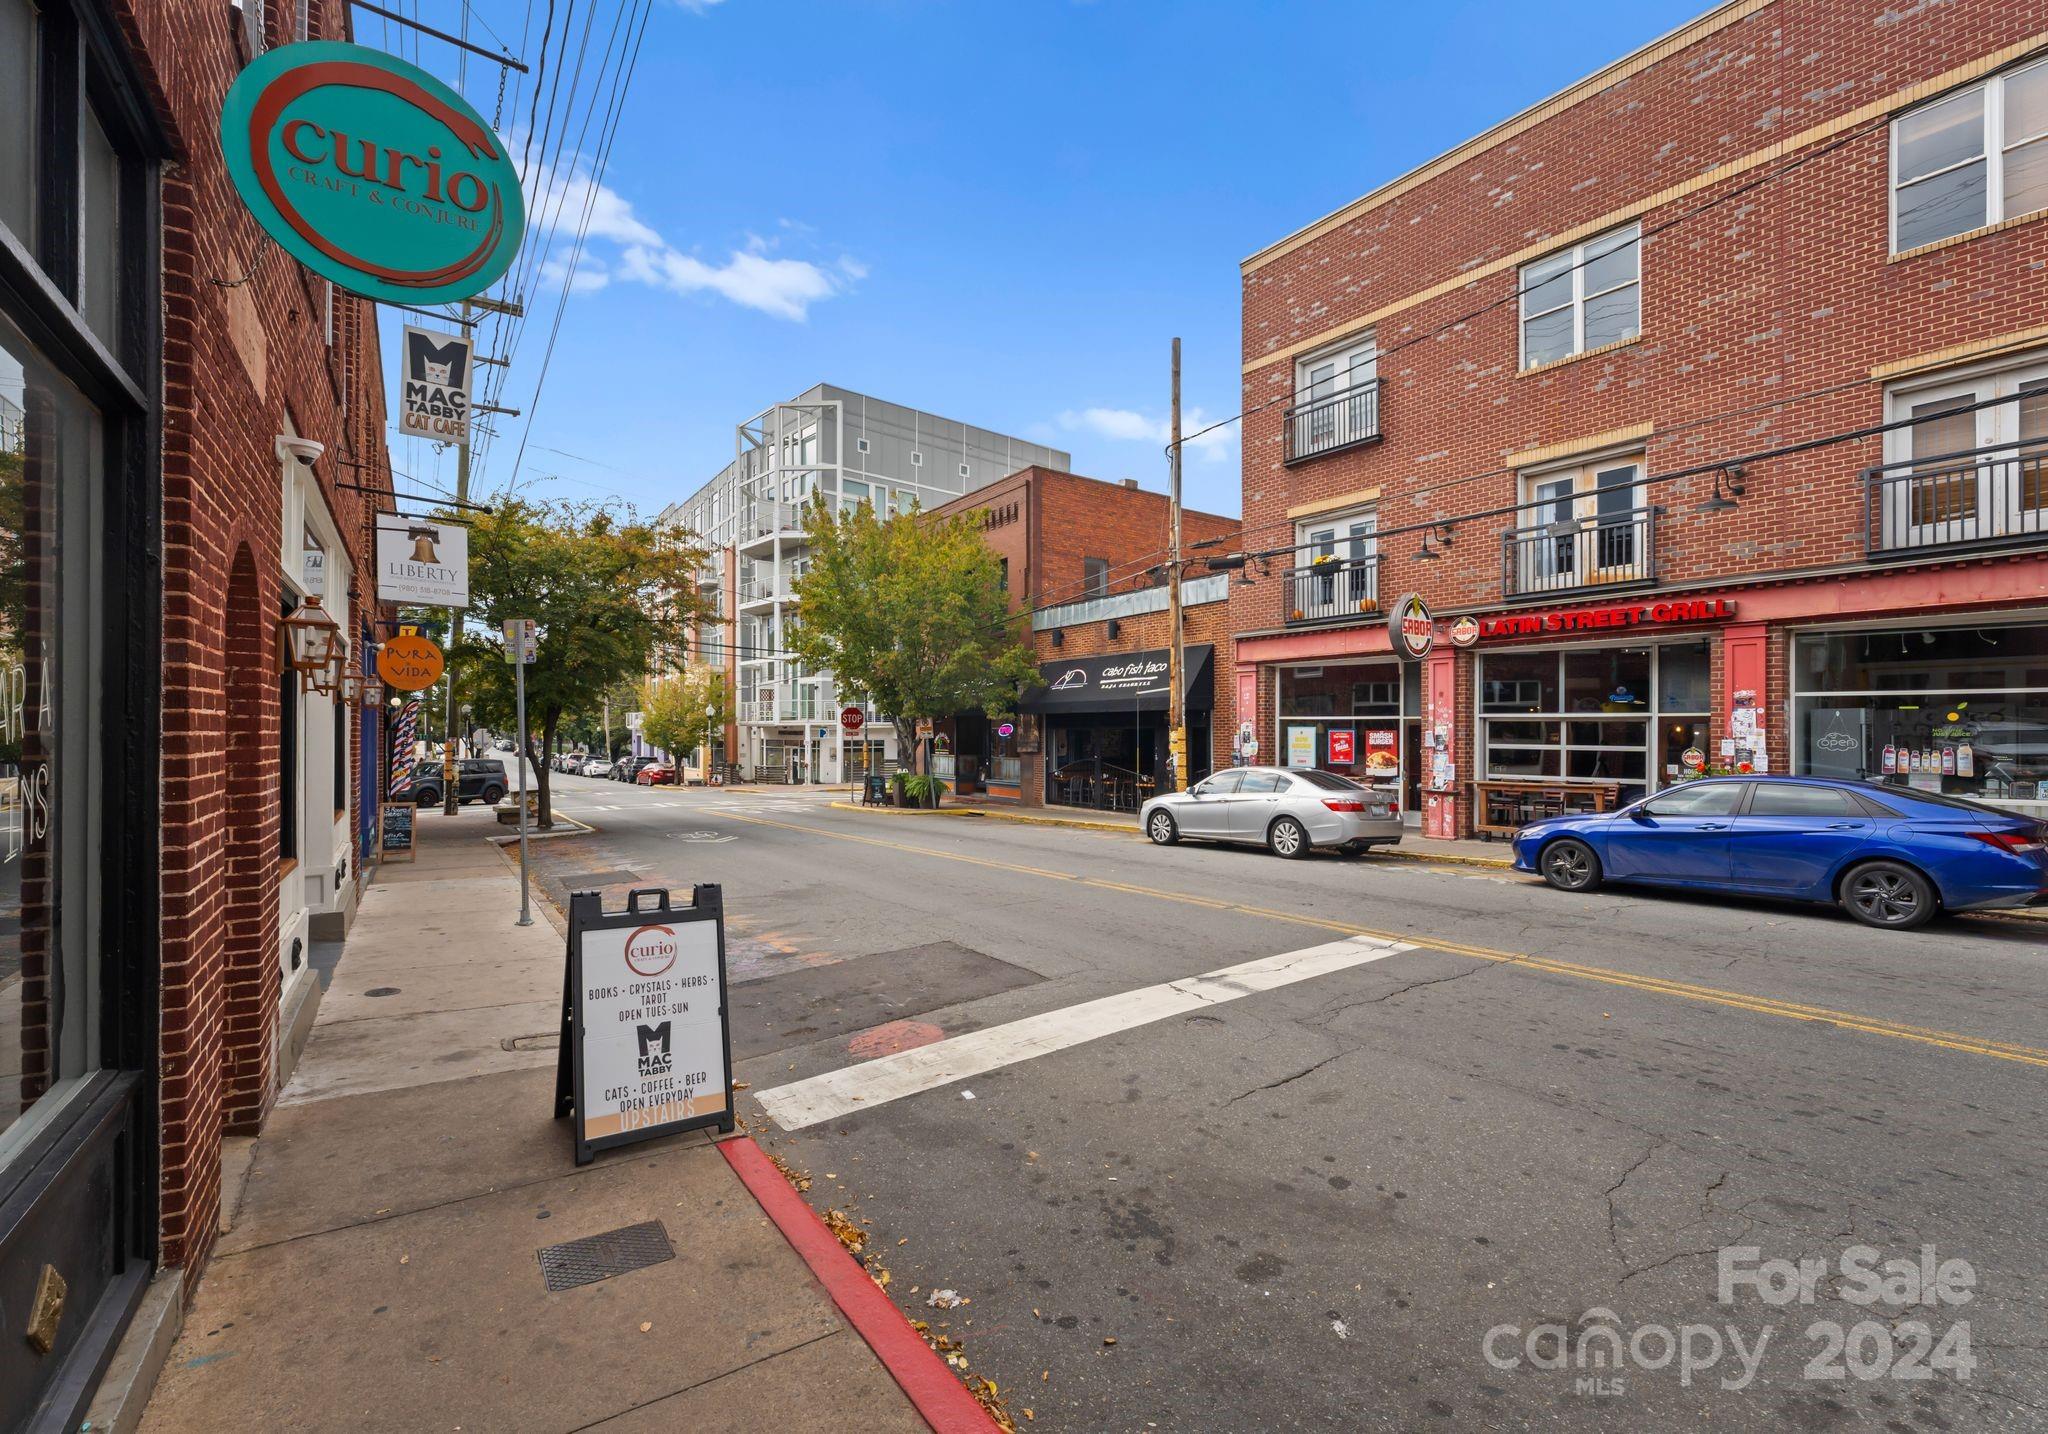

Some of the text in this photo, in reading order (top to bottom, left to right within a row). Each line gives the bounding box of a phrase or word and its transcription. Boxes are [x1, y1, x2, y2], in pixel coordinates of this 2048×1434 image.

[281, 119, 489, 212] curio
[288, 166, 482, 233] CRAFT & CONJURE
[406, 381, 466, 408] MAC
[406, 399, 466, 421] TABBY
[405, 412, 466, 438] CAT CAFE
[390, 562, 458, 581] LIBERTY
[1402, 616, 1432, 636] SABOR
[1480, 599, 1733, 637] LATIN STREET GRILL
[1451, 626, 1478, 636] SABOR
[386, 647, 437, 660] PURA
[391, 666, 432, 677] VIDA
[1102, 661, 1168, 678] cabo fish taco
[842, 714, 863, 723] STOP
[1821, 738, 1856, 748] open
[630, 941, 673, 958] curio
[588, 975, 708, 1000] BOOKS CRYSTALS HERBS
[641, 992, 667, 1006] TAROT
[619, 1002, 689, 1022] OPEN TUES-SUN
[637, 1052, 672, 1069] MAC
[638, 1064, 673, 1078] TABBY
[604, 1071, 707, 1101] CATS COFFEE BEER
[619, 1087, 694, 1113] OPEN EVERYDAY
[619, 1099, 695, 1132] UPSTAIRS
